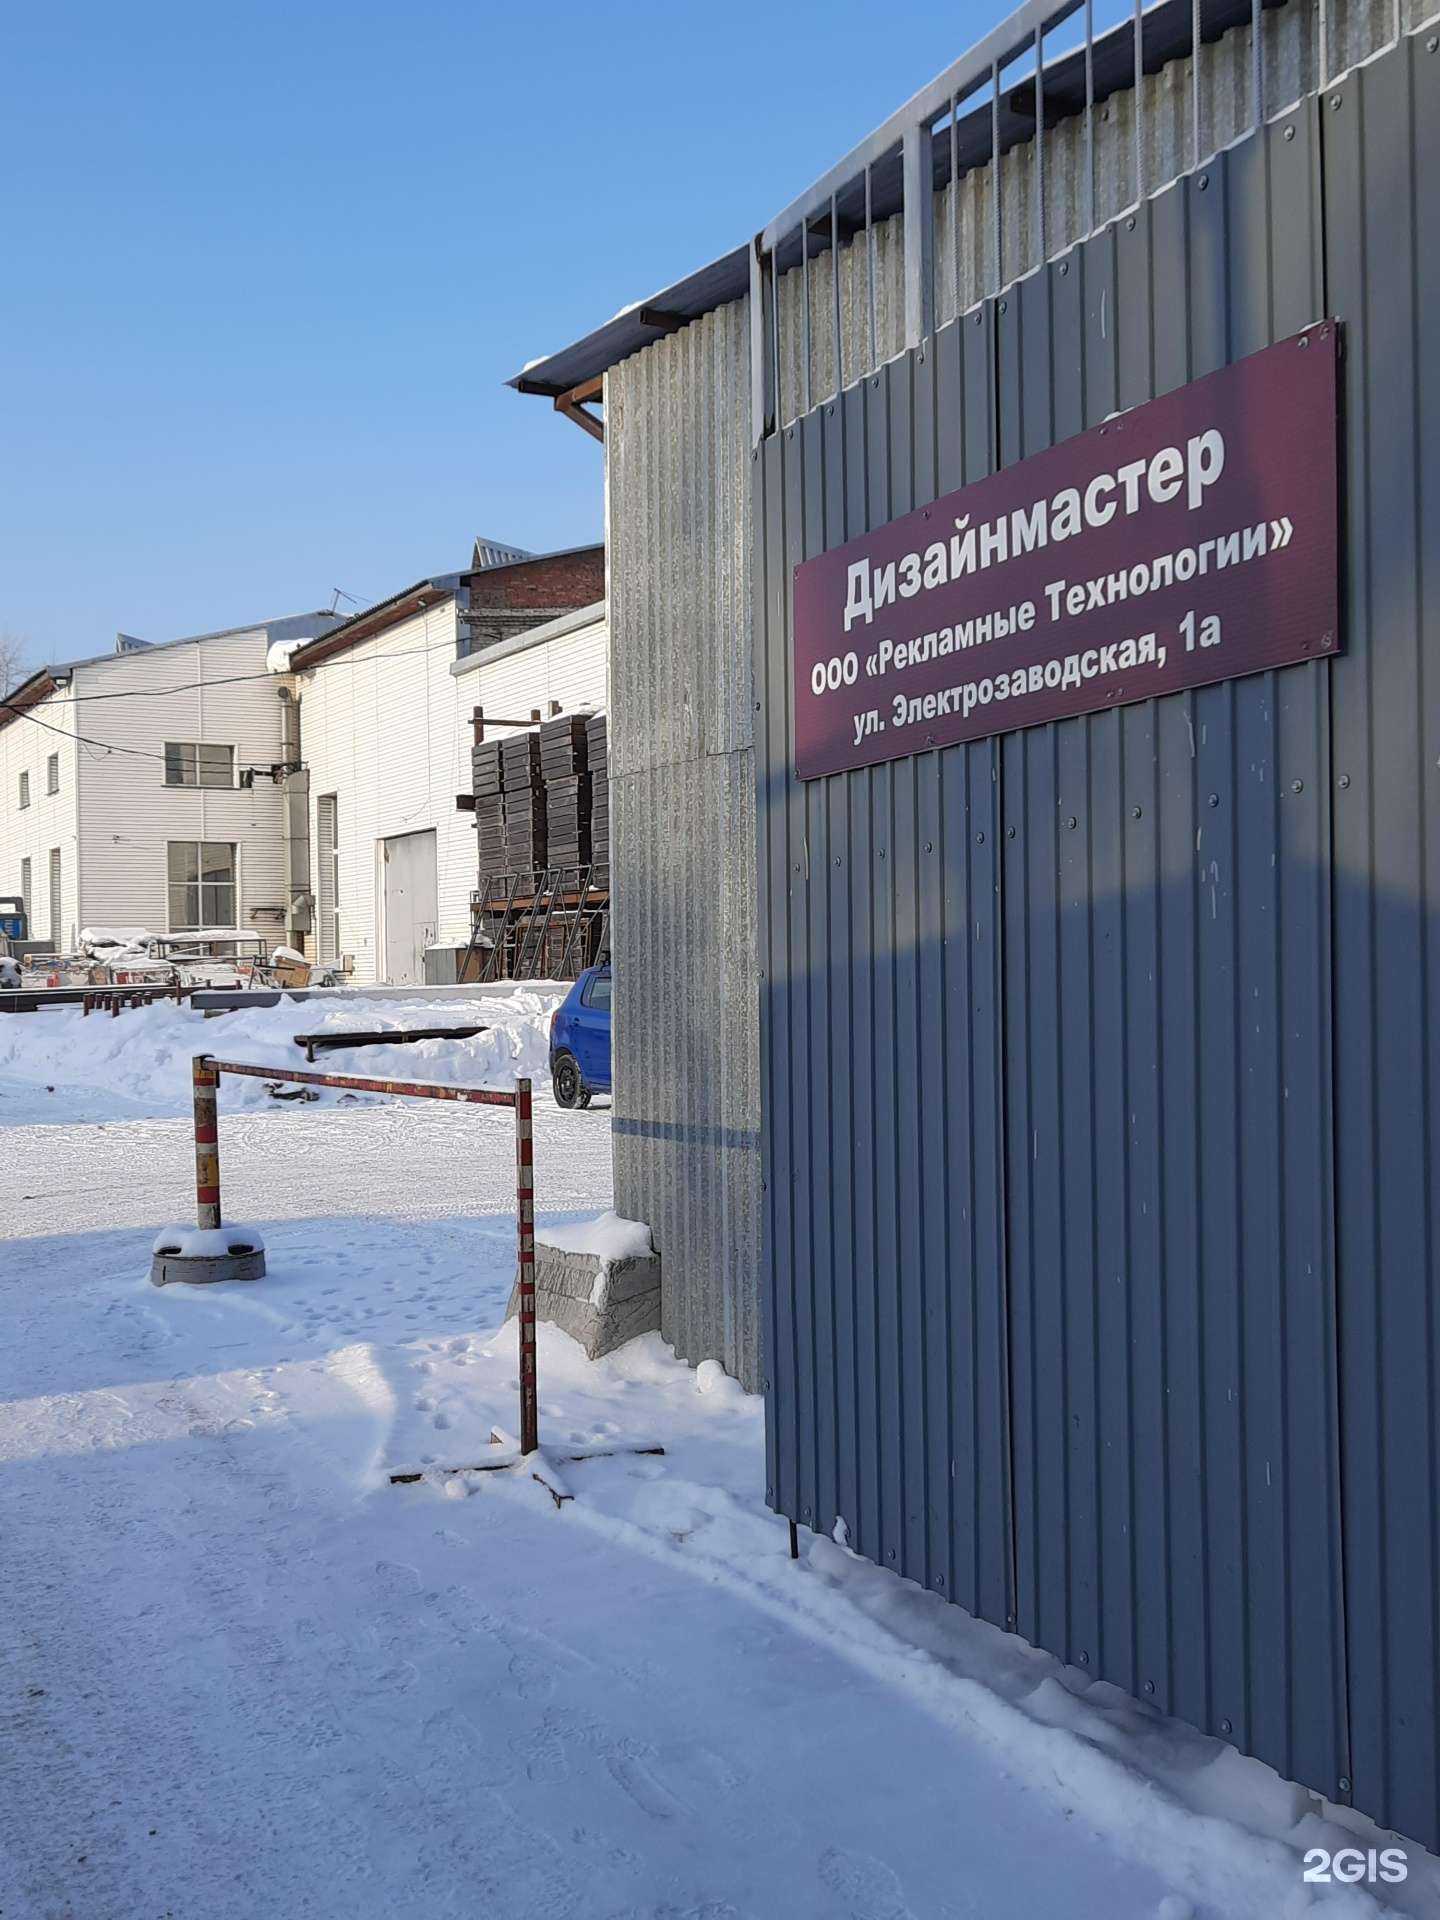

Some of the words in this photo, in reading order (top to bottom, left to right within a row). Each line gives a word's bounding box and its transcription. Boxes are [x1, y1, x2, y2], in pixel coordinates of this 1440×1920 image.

[811, 651, 859, 696] ООО
[866, 601, 1036, 677] «Рекламные
[1044, 516, 1295, 622] Технологии»
[843, 429, 1225, 633] Дизайнмастер
[853, 712, 885, 746] ул.
[892, 632, 1167, 728] Электрозаводская,
[1179, 610, 1222, 652] 1а
